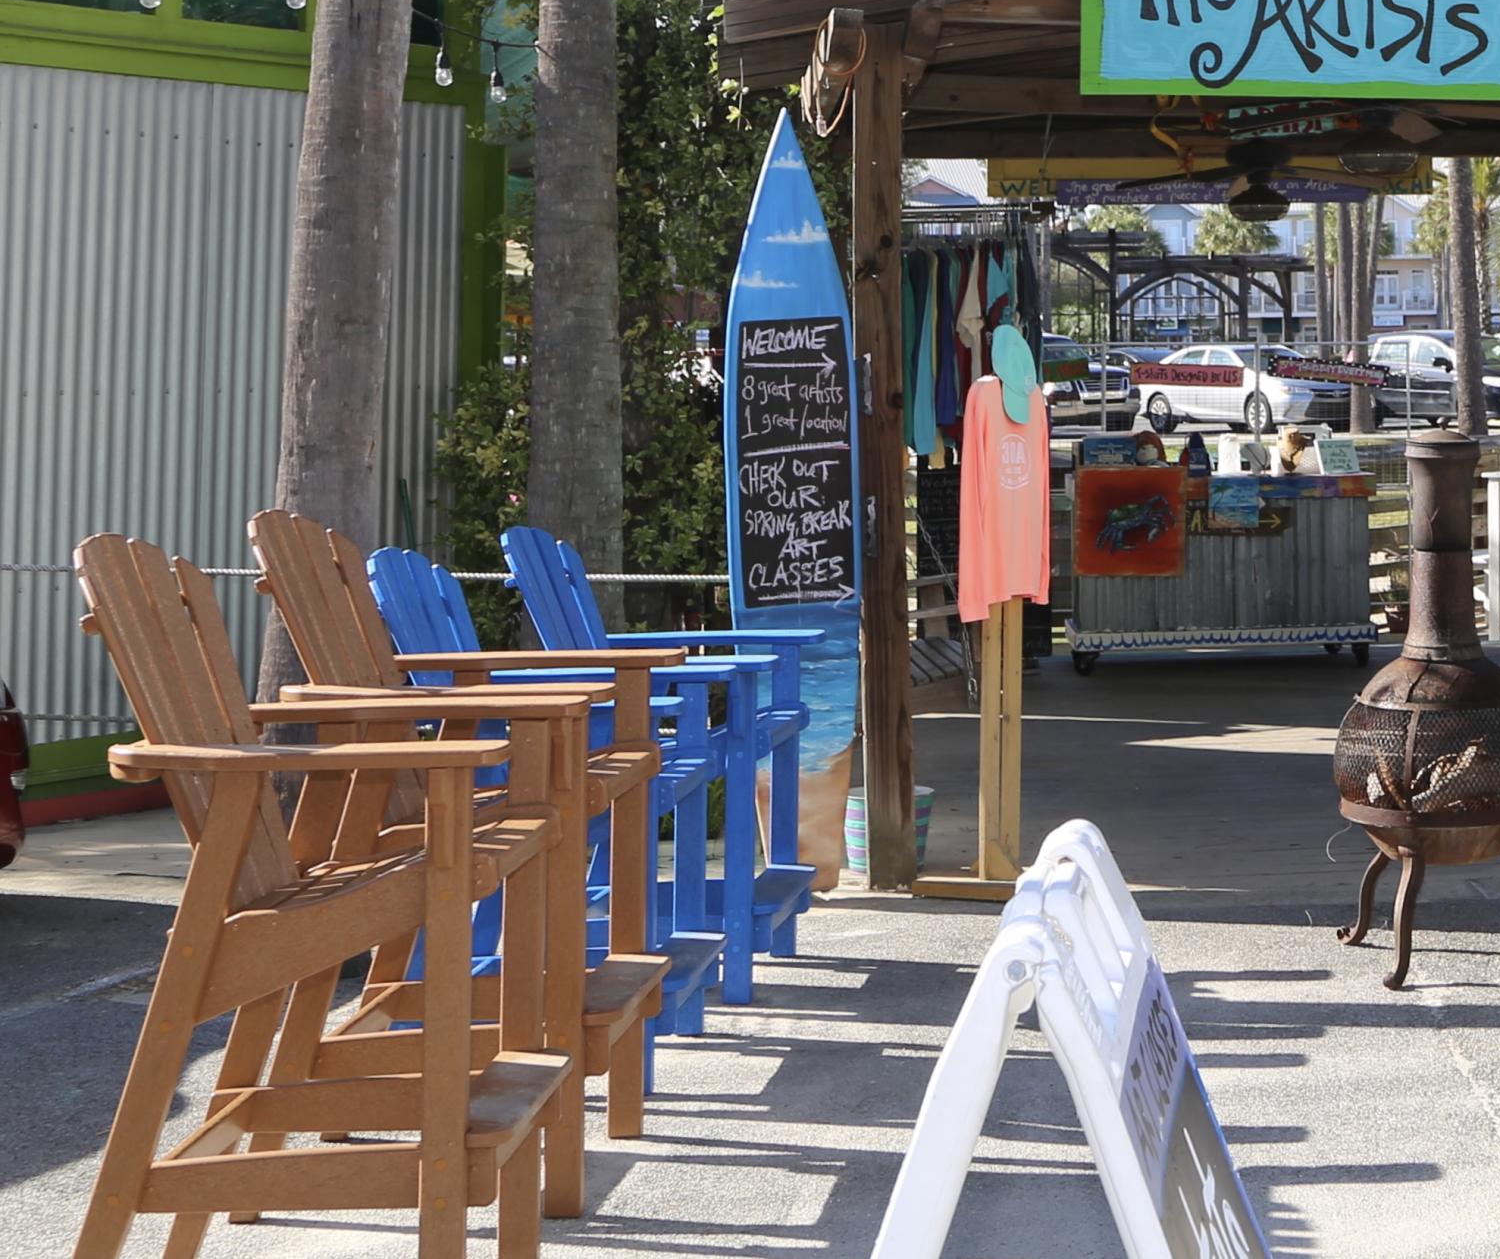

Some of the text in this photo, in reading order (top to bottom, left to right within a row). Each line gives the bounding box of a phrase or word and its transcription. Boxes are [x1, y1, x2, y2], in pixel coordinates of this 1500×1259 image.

[1102, 191, 1150, 205] purchase
[741, 323, 840, 360] WELCOME
[742, 373, 844, 404] 8 great artists
[741, 406, 758, 438] 1
[762, 411, 799, 434] great
[739, 456, 840, 494] CHECK OUT
[799, 501, 852, 534] BREAK
[778, 532, 827, 560] ART
[749, 556, 844, 589] CLASSES
